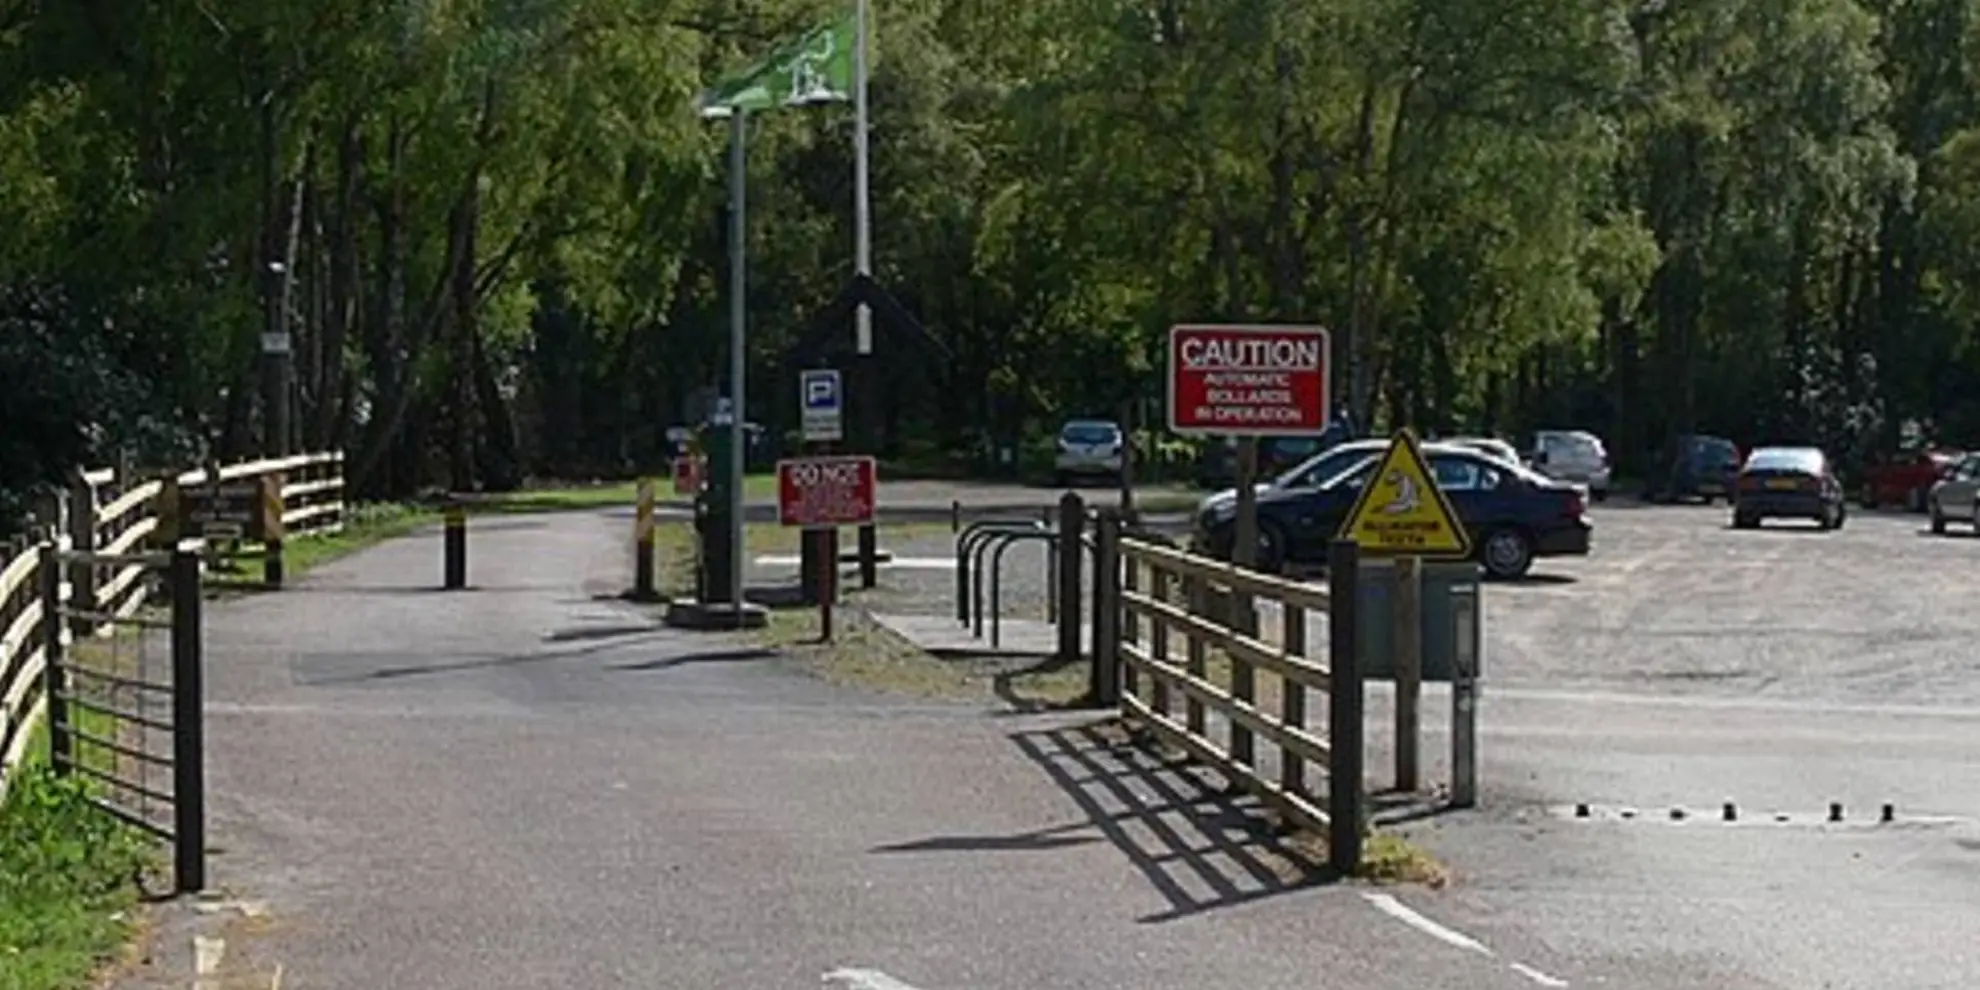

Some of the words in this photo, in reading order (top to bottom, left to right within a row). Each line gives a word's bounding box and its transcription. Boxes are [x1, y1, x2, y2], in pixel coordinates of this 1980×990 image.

[1182, 339, 1319, 366] CAUTION
[1203, 373, 1291, 387] AUTOMATIC
[809, 381, 832, 404] P
[1206, 389, 1292, 404] BOLLARDS
[1195, 405, 1212, 420] IN
[1215, 406, 1302, 422] OPERATION
